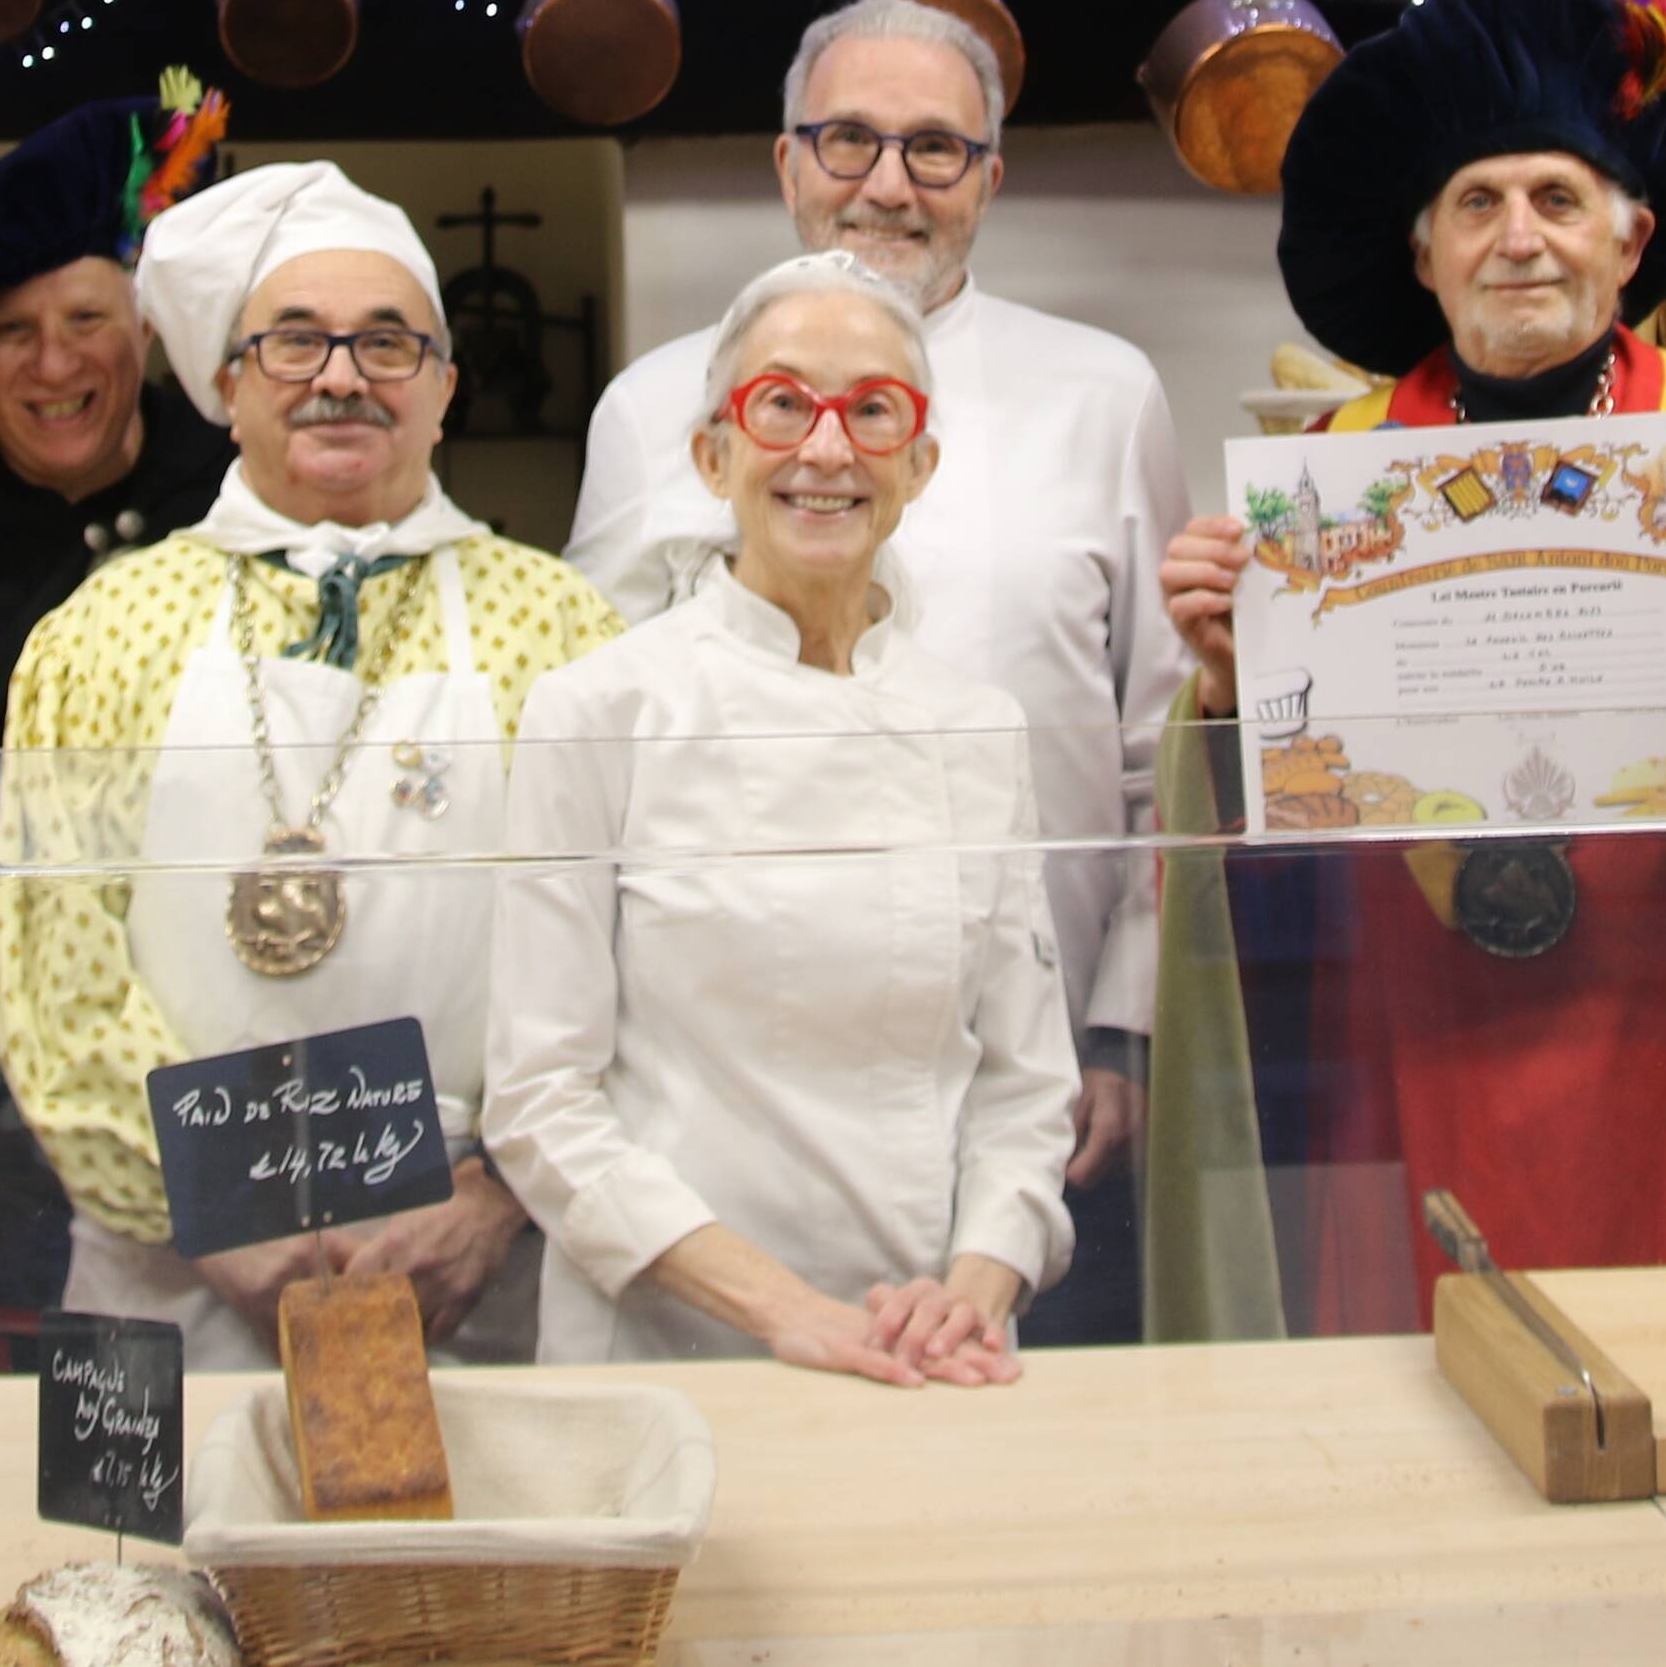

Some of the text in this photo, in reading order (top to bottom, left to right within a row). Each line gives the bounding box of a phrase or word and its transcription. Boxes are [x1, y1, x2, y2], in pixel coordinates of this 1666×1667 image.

[1535, 550, 1594, 567] Antoni
[1552, 586, 1566, 596] en
[172, 1065, 424, 1127] PAIN DE RIZ NATURE
